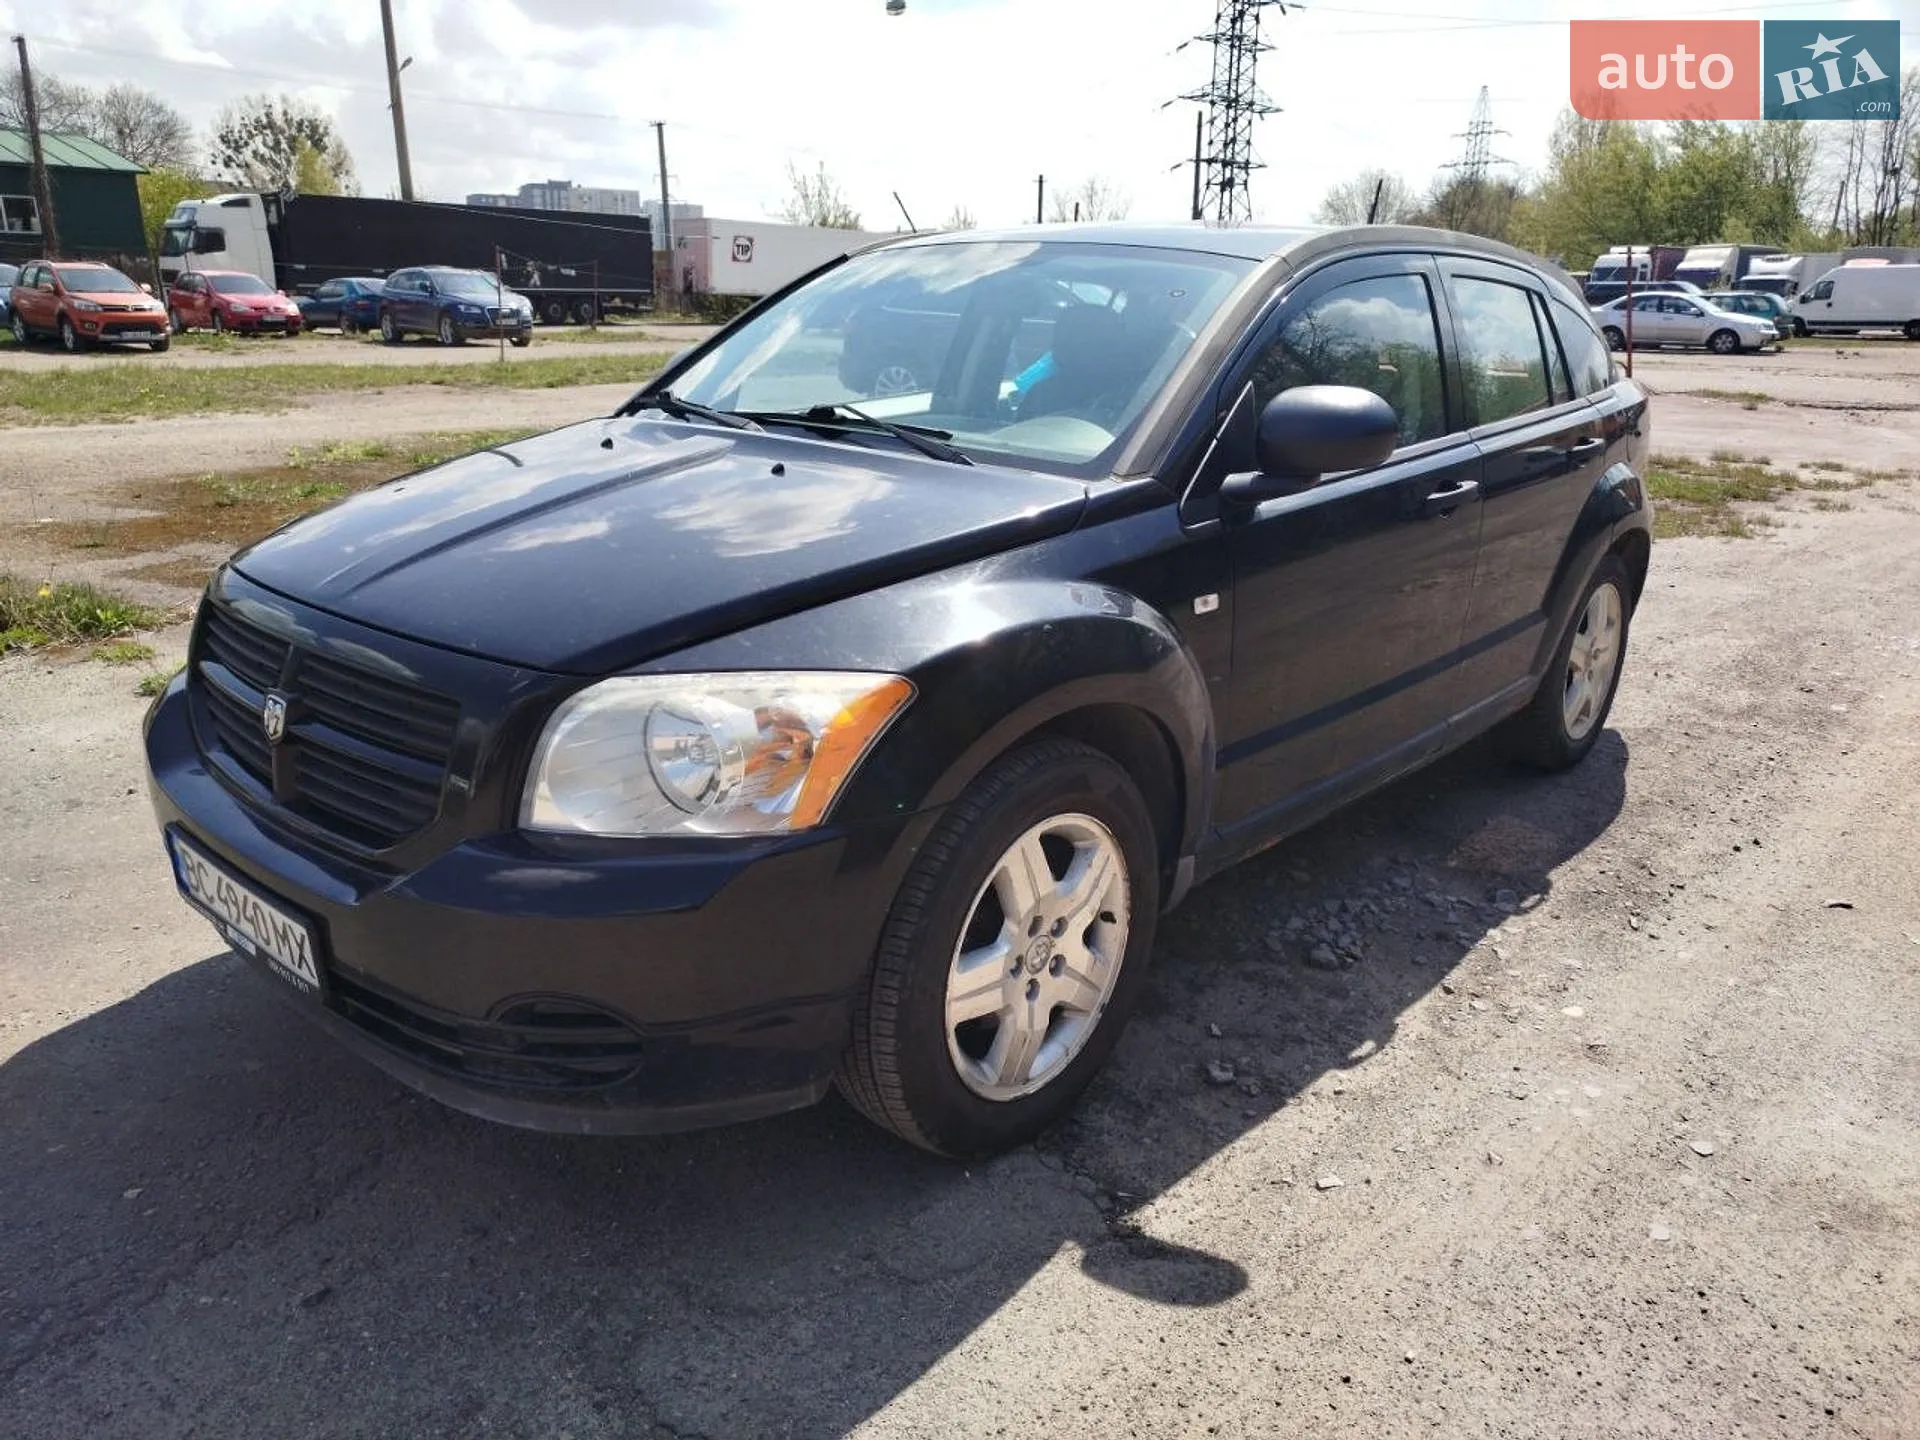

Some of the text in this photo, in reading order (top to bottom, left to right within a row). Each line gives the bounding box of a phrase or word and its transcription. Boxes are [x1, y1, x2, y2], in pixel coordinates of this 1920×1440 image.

[735, 244, 750, 256] TIP
[217, 877, 271, 946] 4940
[270, 914, 316, 980] MX
